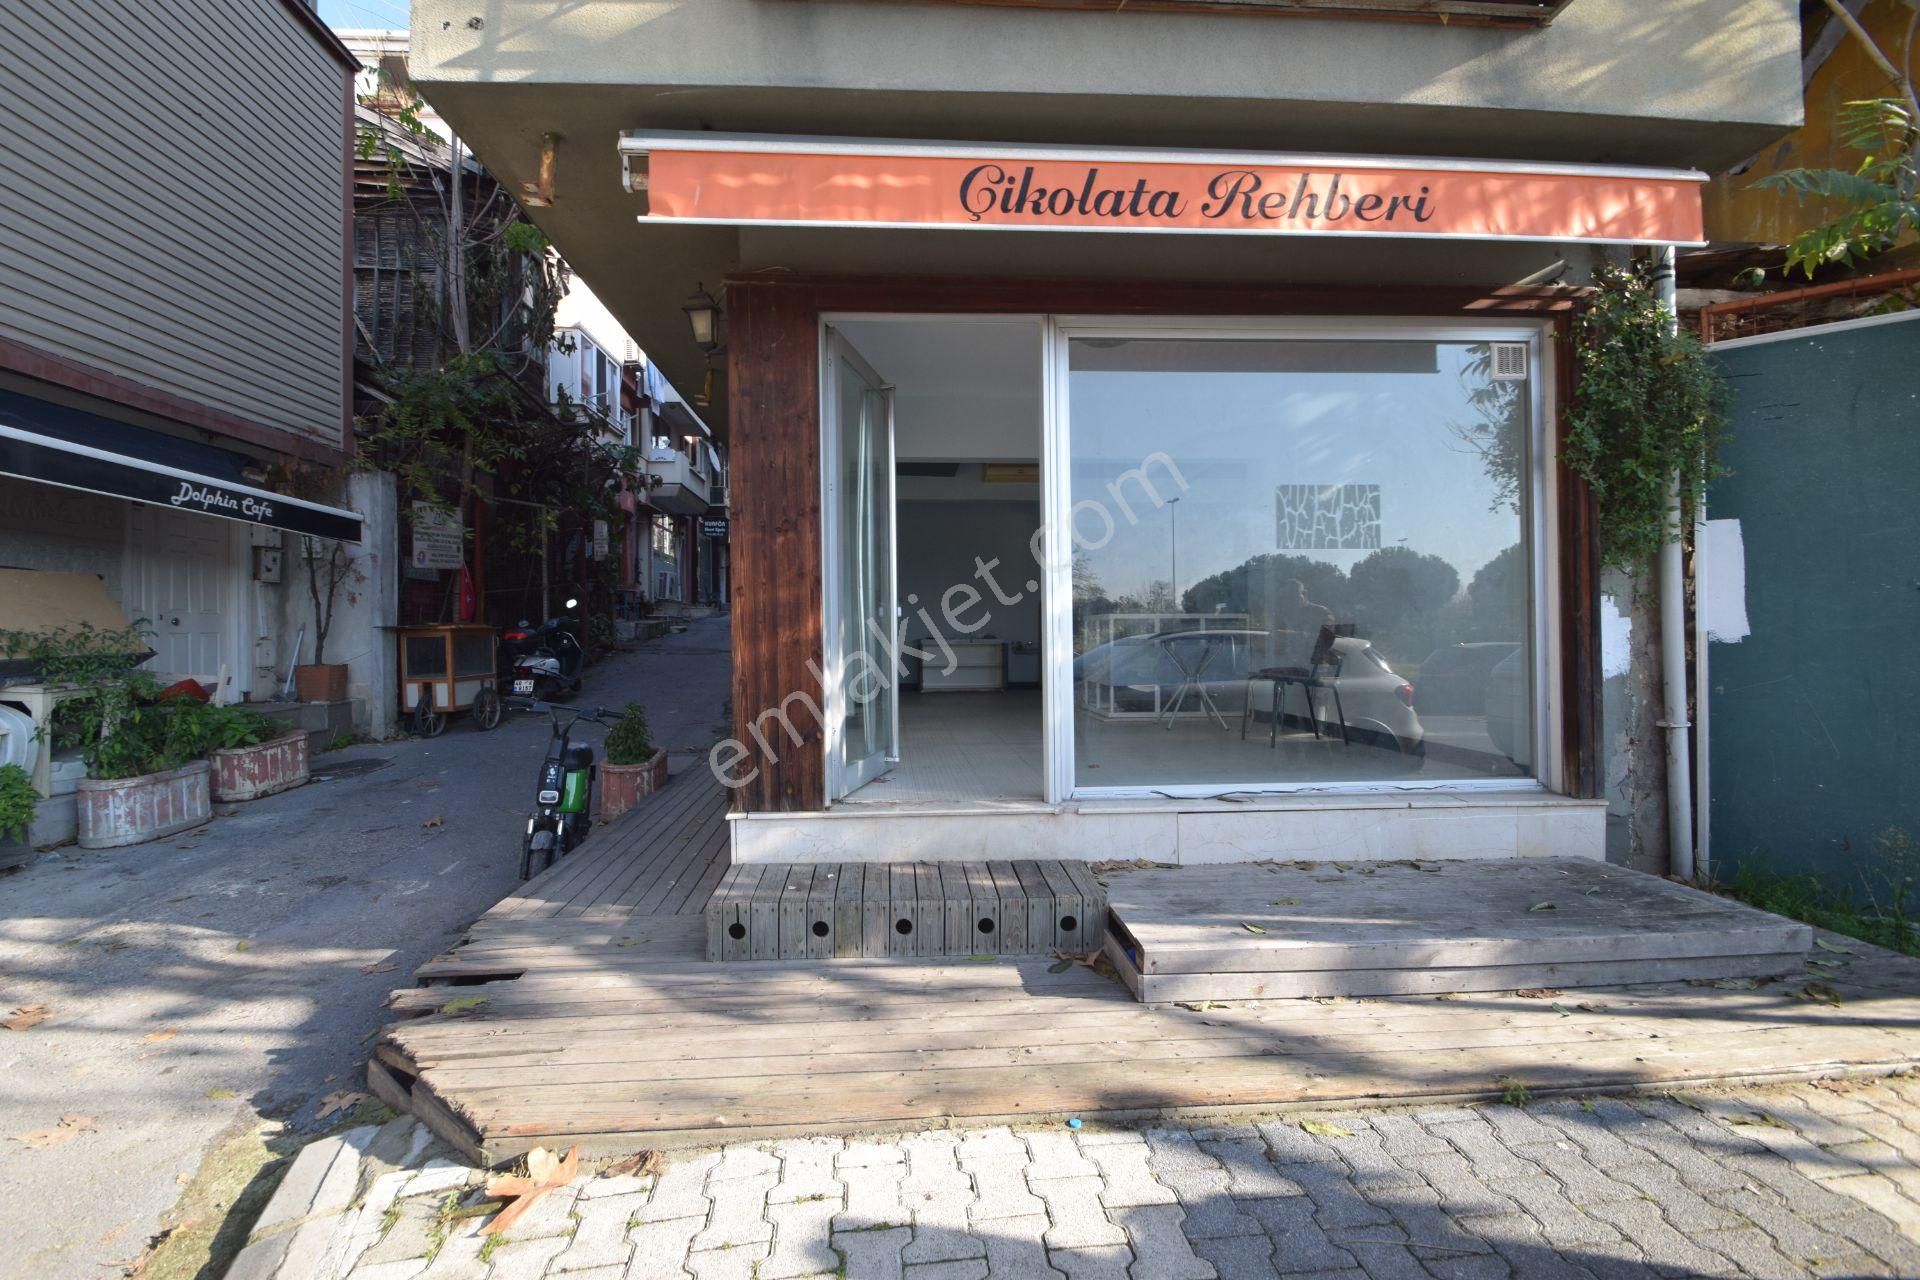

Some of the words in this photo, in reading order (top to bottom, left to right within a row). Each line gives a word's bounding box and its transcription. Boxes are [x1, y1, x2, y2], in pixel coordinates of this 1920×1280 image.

[959, 164, 1188, 222] Çikolata
[1200, 170, 1434, 223] Rehberi
[171, 482, 238, 510] Dolphin
[242, 497, 273, 521] Cafe
